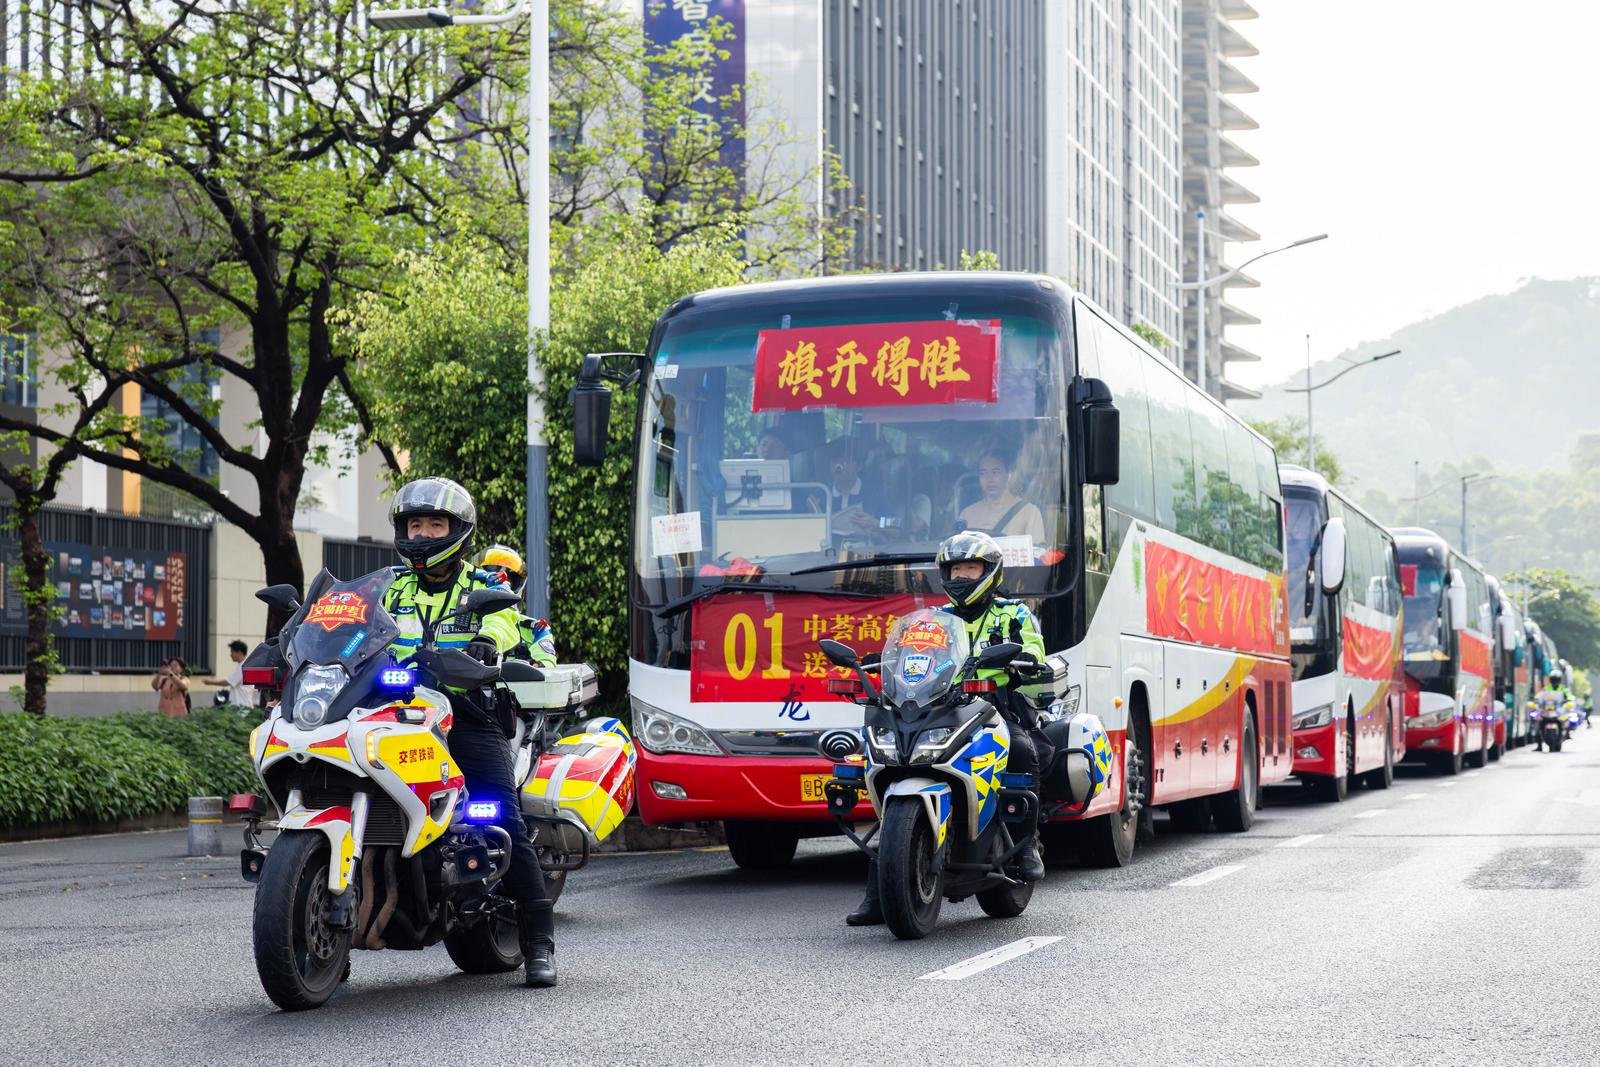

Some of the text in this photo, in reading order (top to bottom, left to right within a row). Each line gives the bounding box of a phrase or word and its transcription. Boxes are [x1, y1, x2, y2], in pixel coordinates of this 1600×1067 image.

[778, 336, 971, 399] 旗开得胜
[724, 612, 791, 681] 01
